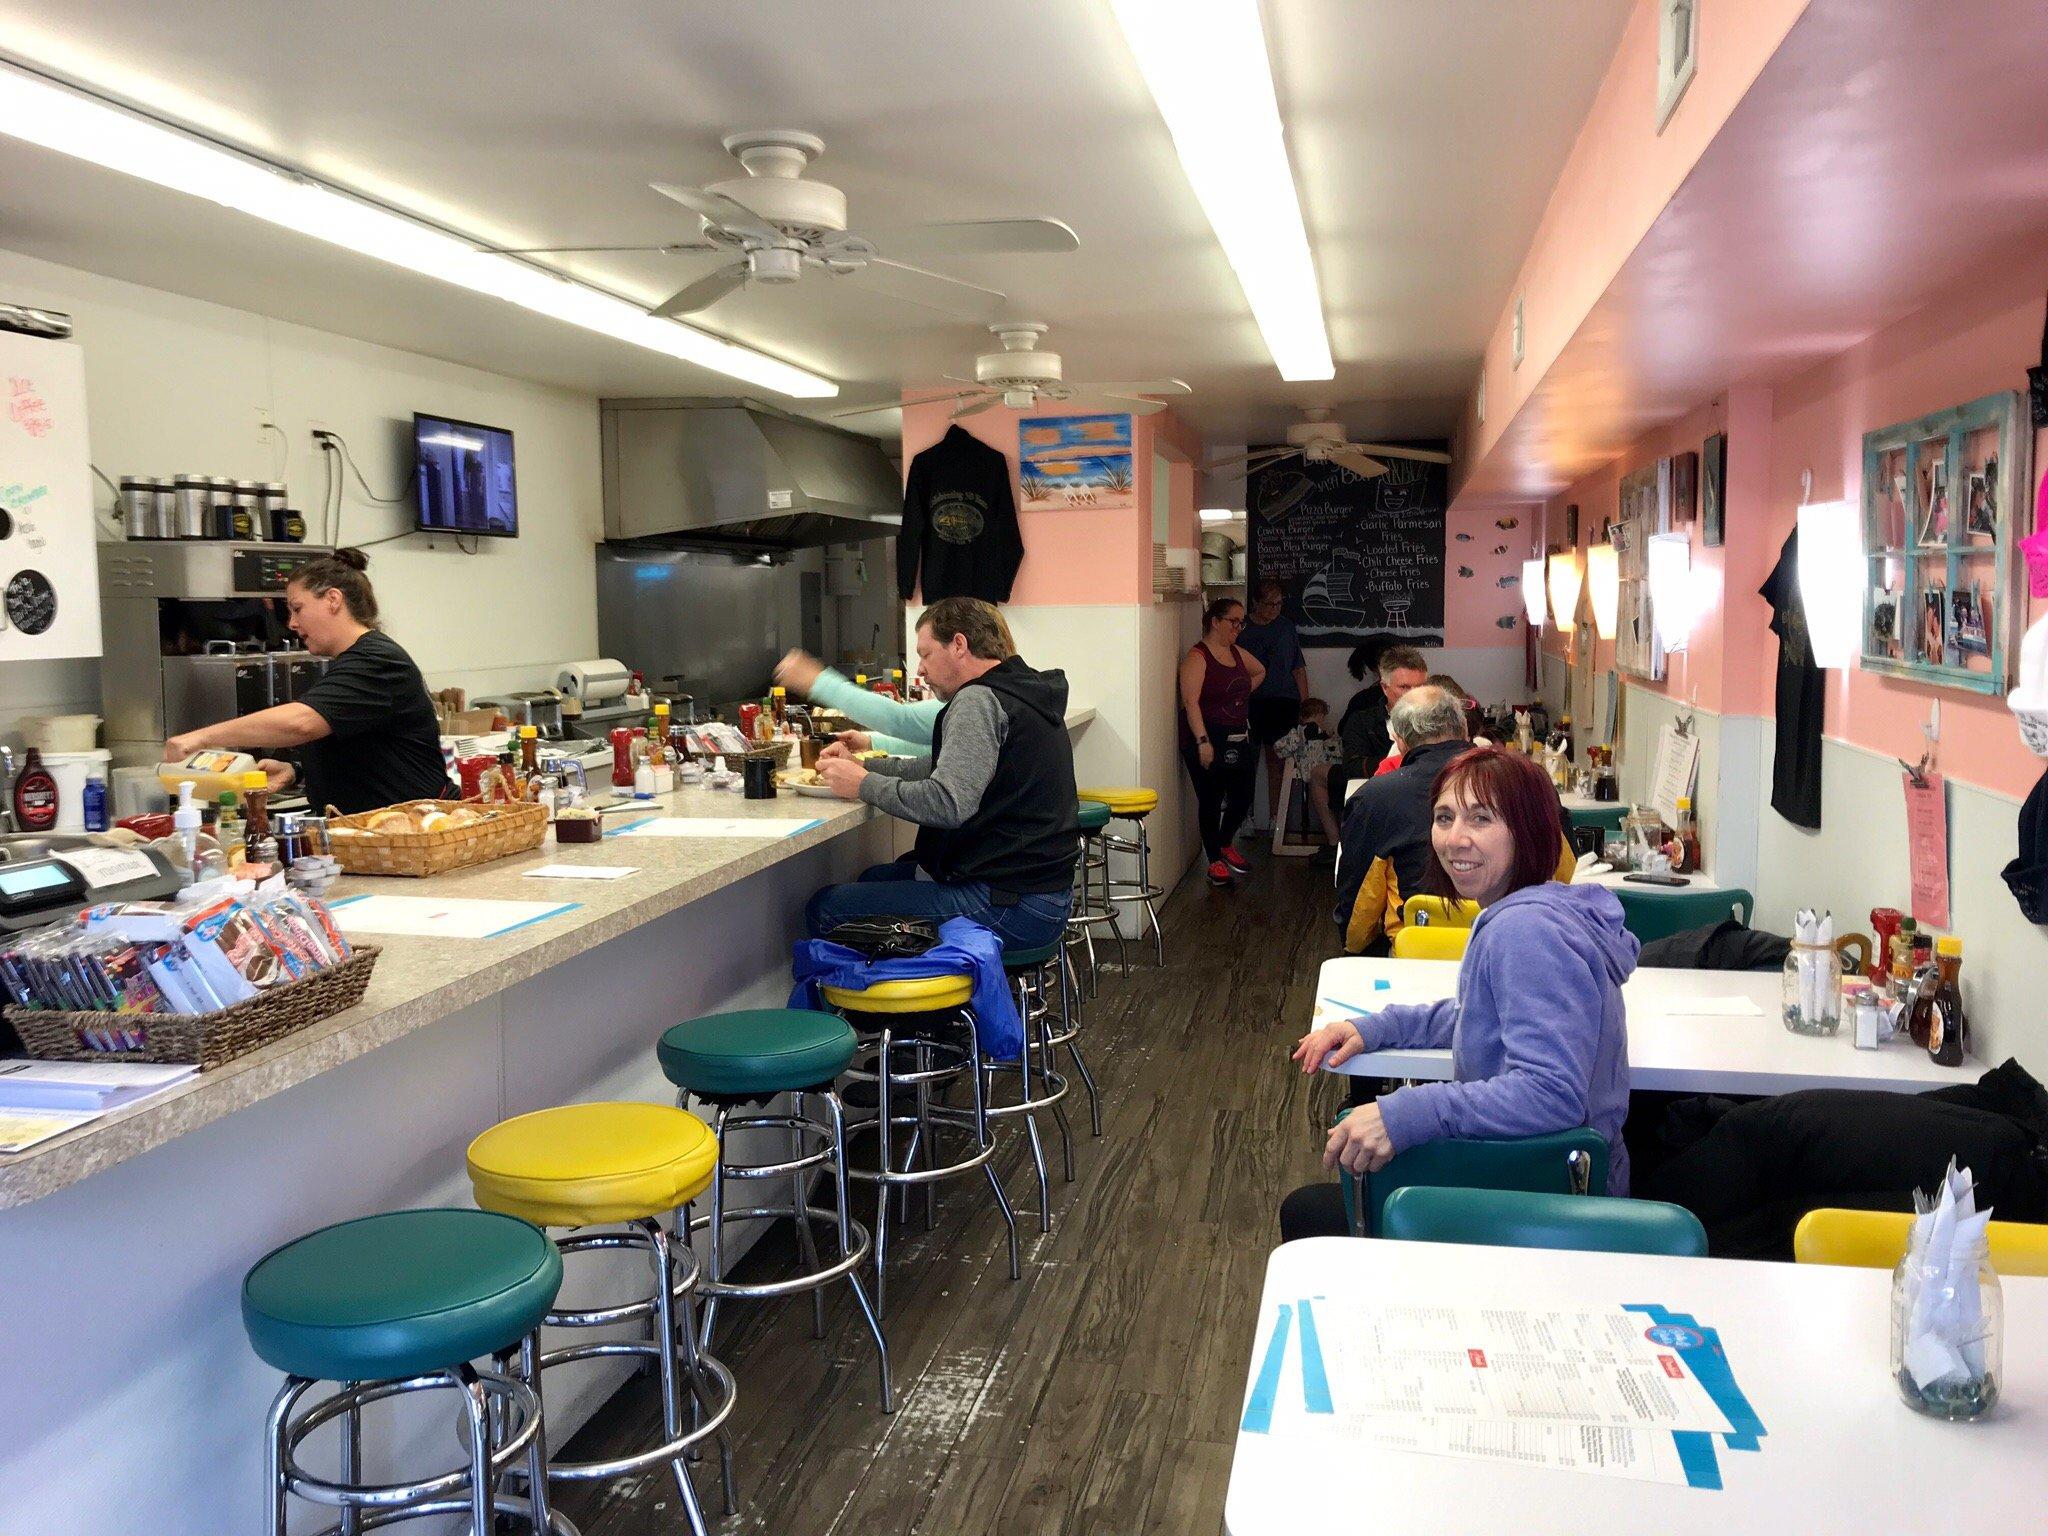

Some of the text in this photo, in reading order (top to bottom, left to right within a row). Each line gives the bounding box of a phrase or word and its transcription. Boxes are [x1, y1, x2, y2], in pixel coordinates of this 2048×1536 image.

[1324, 501, 1354, 517] Burger
[1361, 518, 1388, 530] Garlic
[1393, 517, 1442, 529] Parmesan
[1381, 530, 1403, 542] Fries
[1302, 540, 1329, 554] Burger
[1366, 541, 1426, 555] Loaded Fries
[1362, 553, 1439, 568] Chili Cheese Fries
[1370, 566, 1421, 579] Cheese Fries
[1368, 578, 1430, 592] Buffalo Fries
